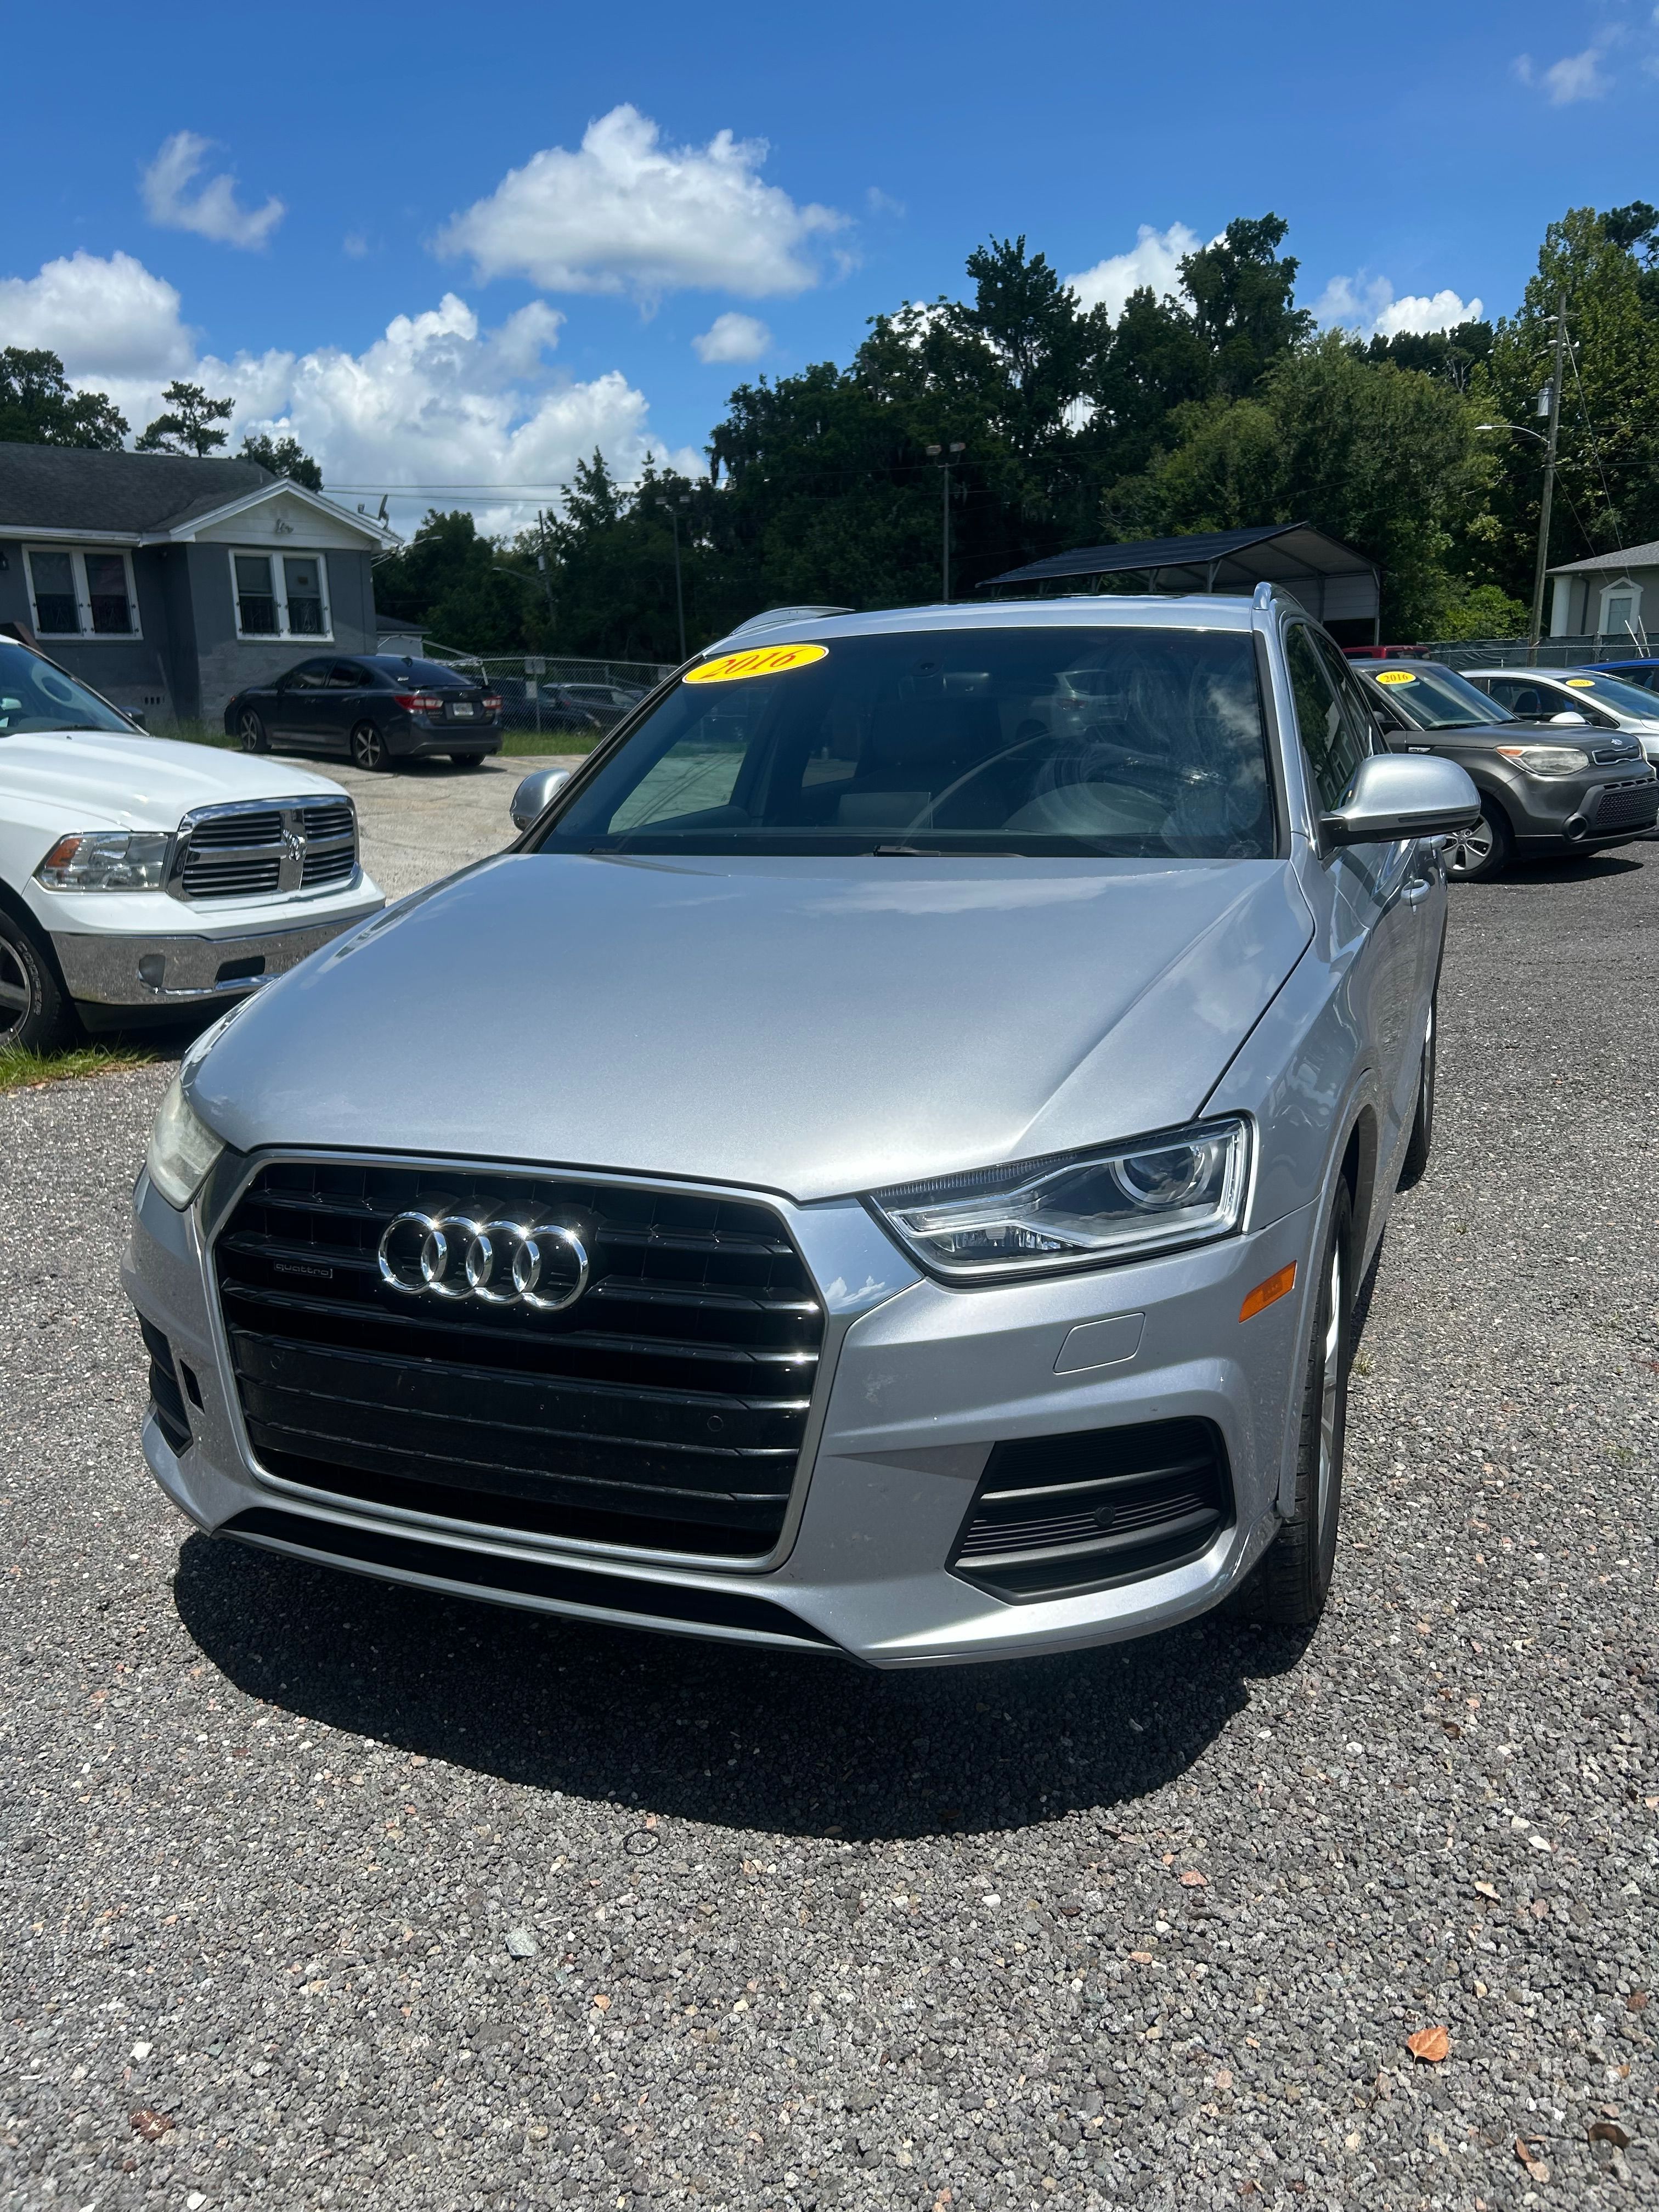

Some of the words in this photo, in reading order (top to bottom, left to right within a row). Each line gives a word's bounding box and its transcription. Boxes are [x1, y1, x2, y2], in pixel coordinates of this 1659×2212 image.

[697, 647, 811, 680] 2016
[1383, 674, 1408, 682] 2016
[16, 940, 42, 1015] COOPER
[276, 1263, 329, 1276] quattro
